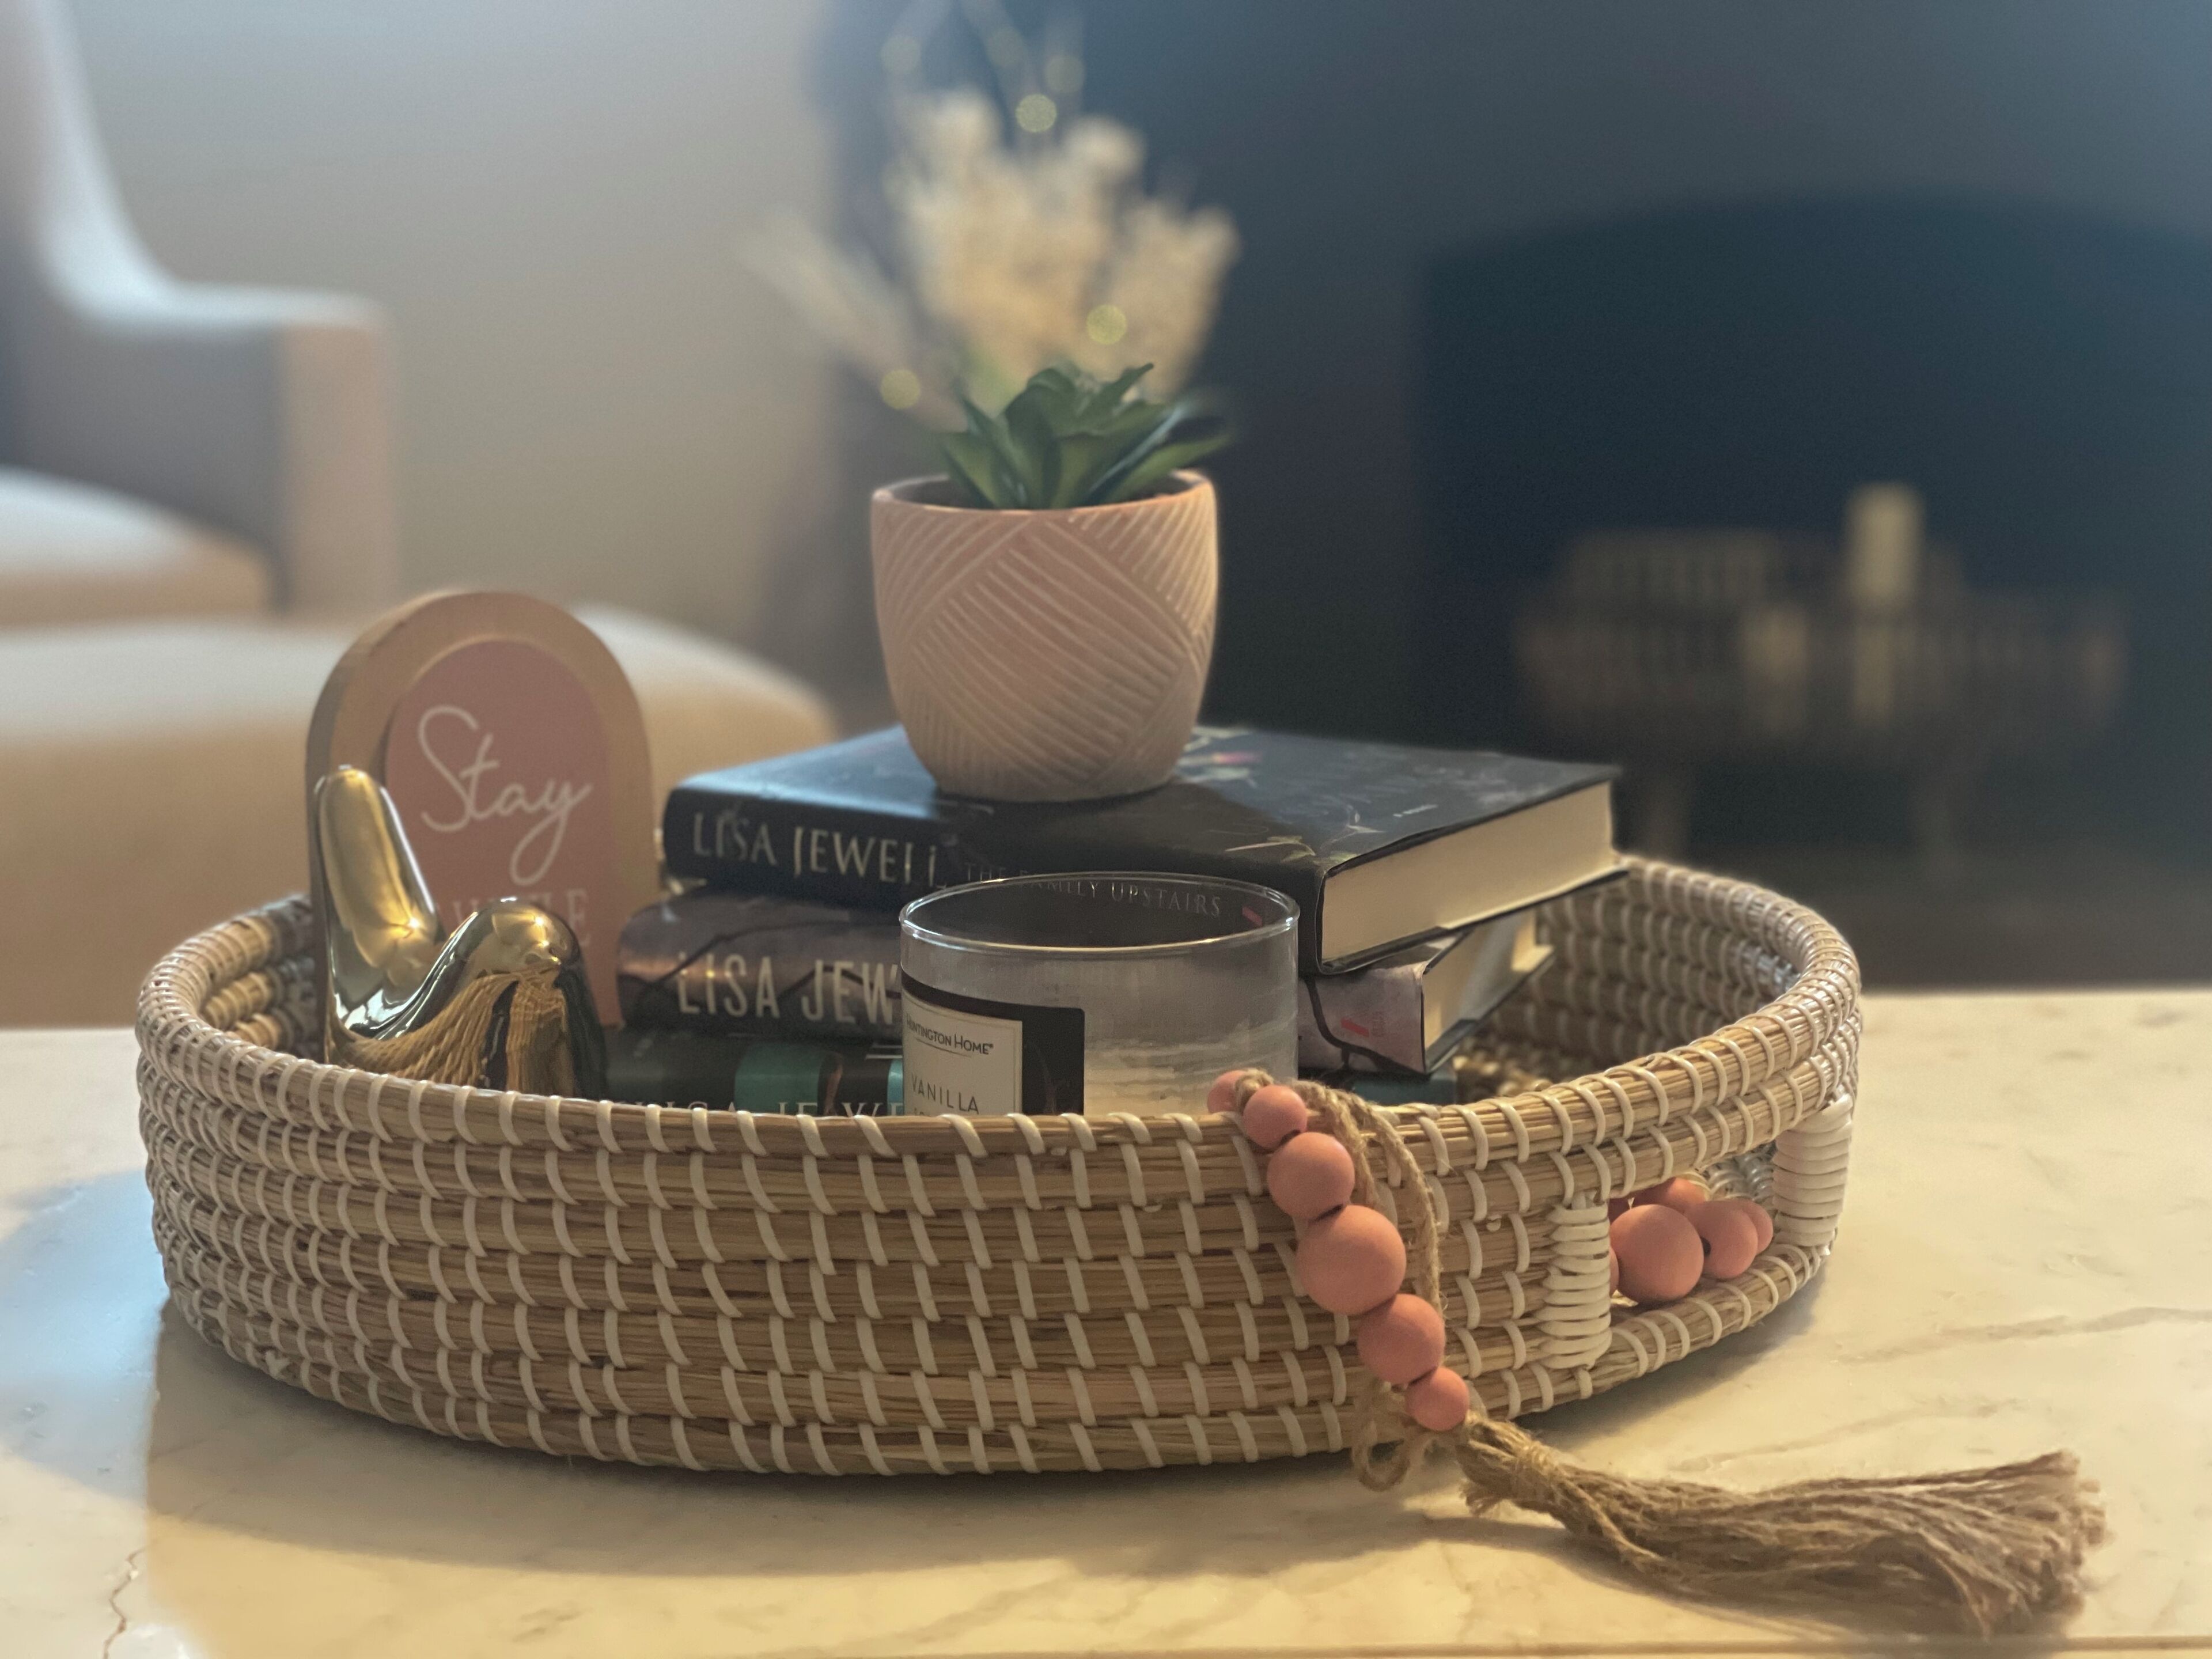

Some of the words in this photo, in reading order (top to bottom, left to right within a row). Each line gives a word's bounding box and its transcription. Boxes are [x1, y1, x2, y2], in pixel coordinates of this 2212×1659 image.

[418, 704, 594, 887] Stay
[694, 812, 777, 865] LISA
[1111, 881, 1221, 918] UPSTAIRS
[677, 952, 781, 1018] LISA
[911, 1072, 979, 1115] VANILLA
